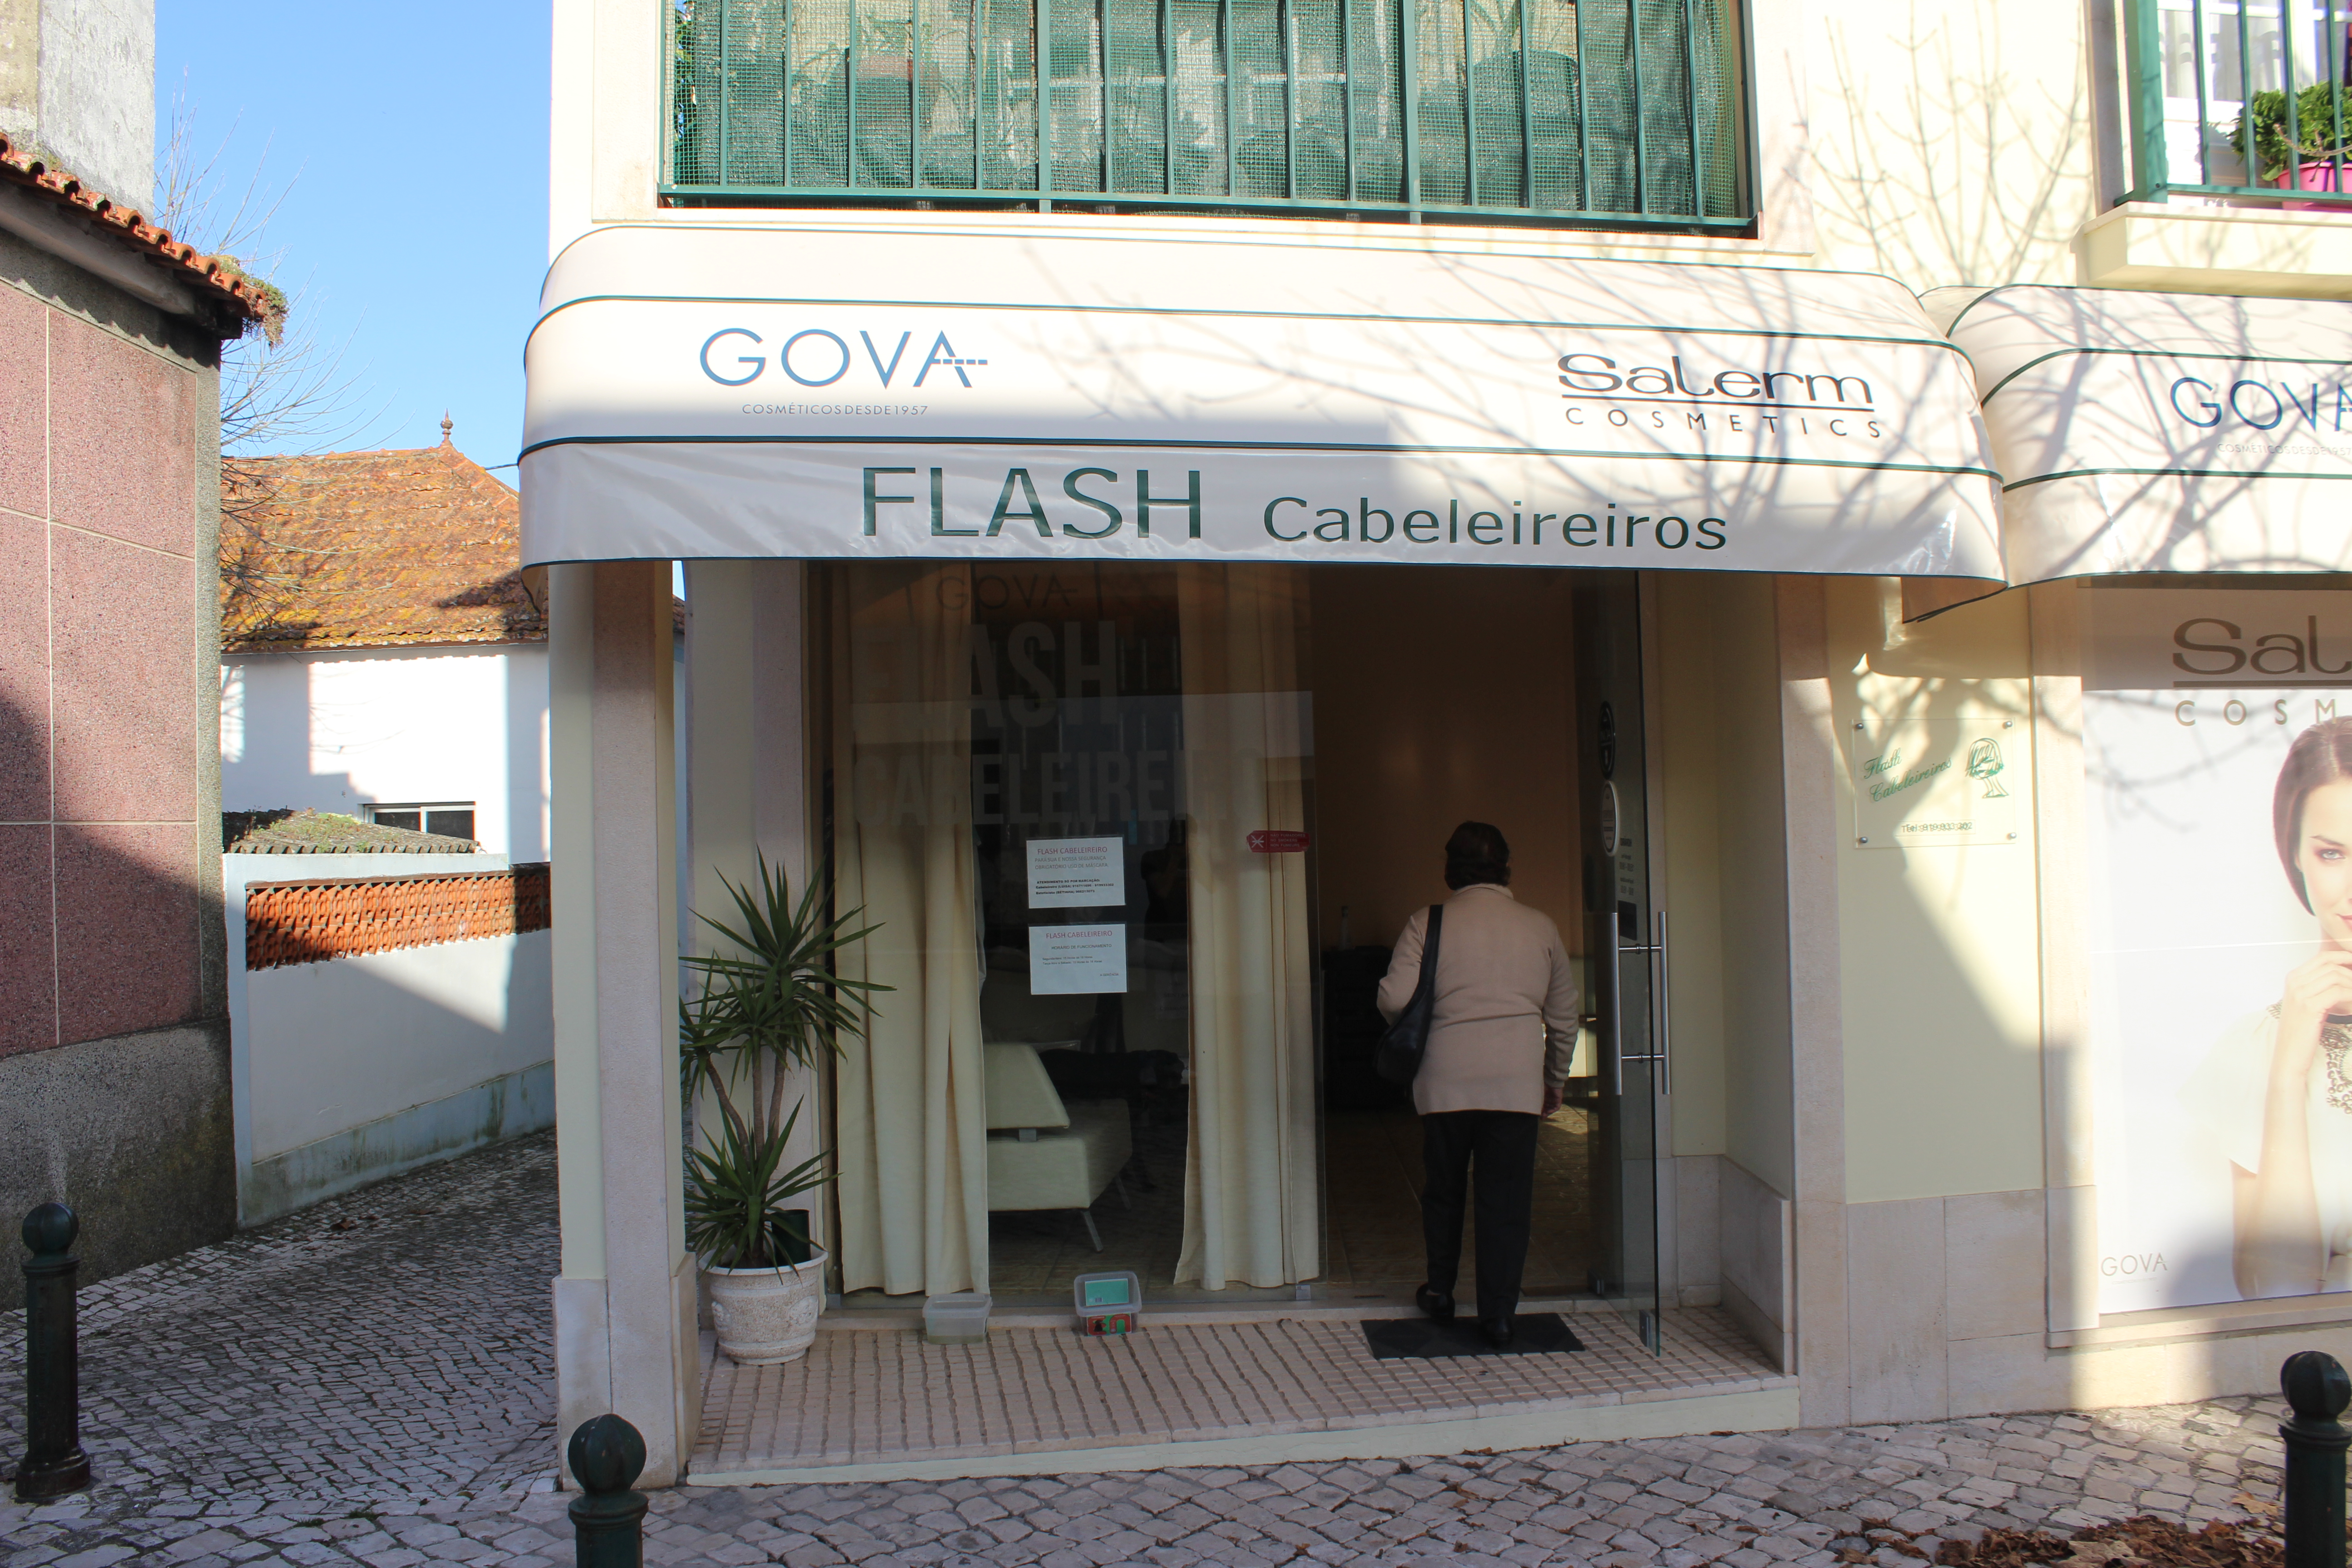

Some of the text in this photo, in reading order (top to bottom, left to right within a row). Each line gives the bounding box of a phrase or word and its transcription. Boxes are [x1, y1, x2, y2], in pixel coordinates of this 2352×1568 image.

[700, 328, 988, 389] GOVA
[1558, 353, 1873, 404] Salerm
[1565, 407, 1881, 438] COSMETICS
[863, 467, 1726, 550] FLASH Cabeleireiros
[1863, 747, 1902, 779] Flash
[1869, 757, 1952, 802] Cabeleireiros
[2101, 1252, 2170, 1276] GOVA
